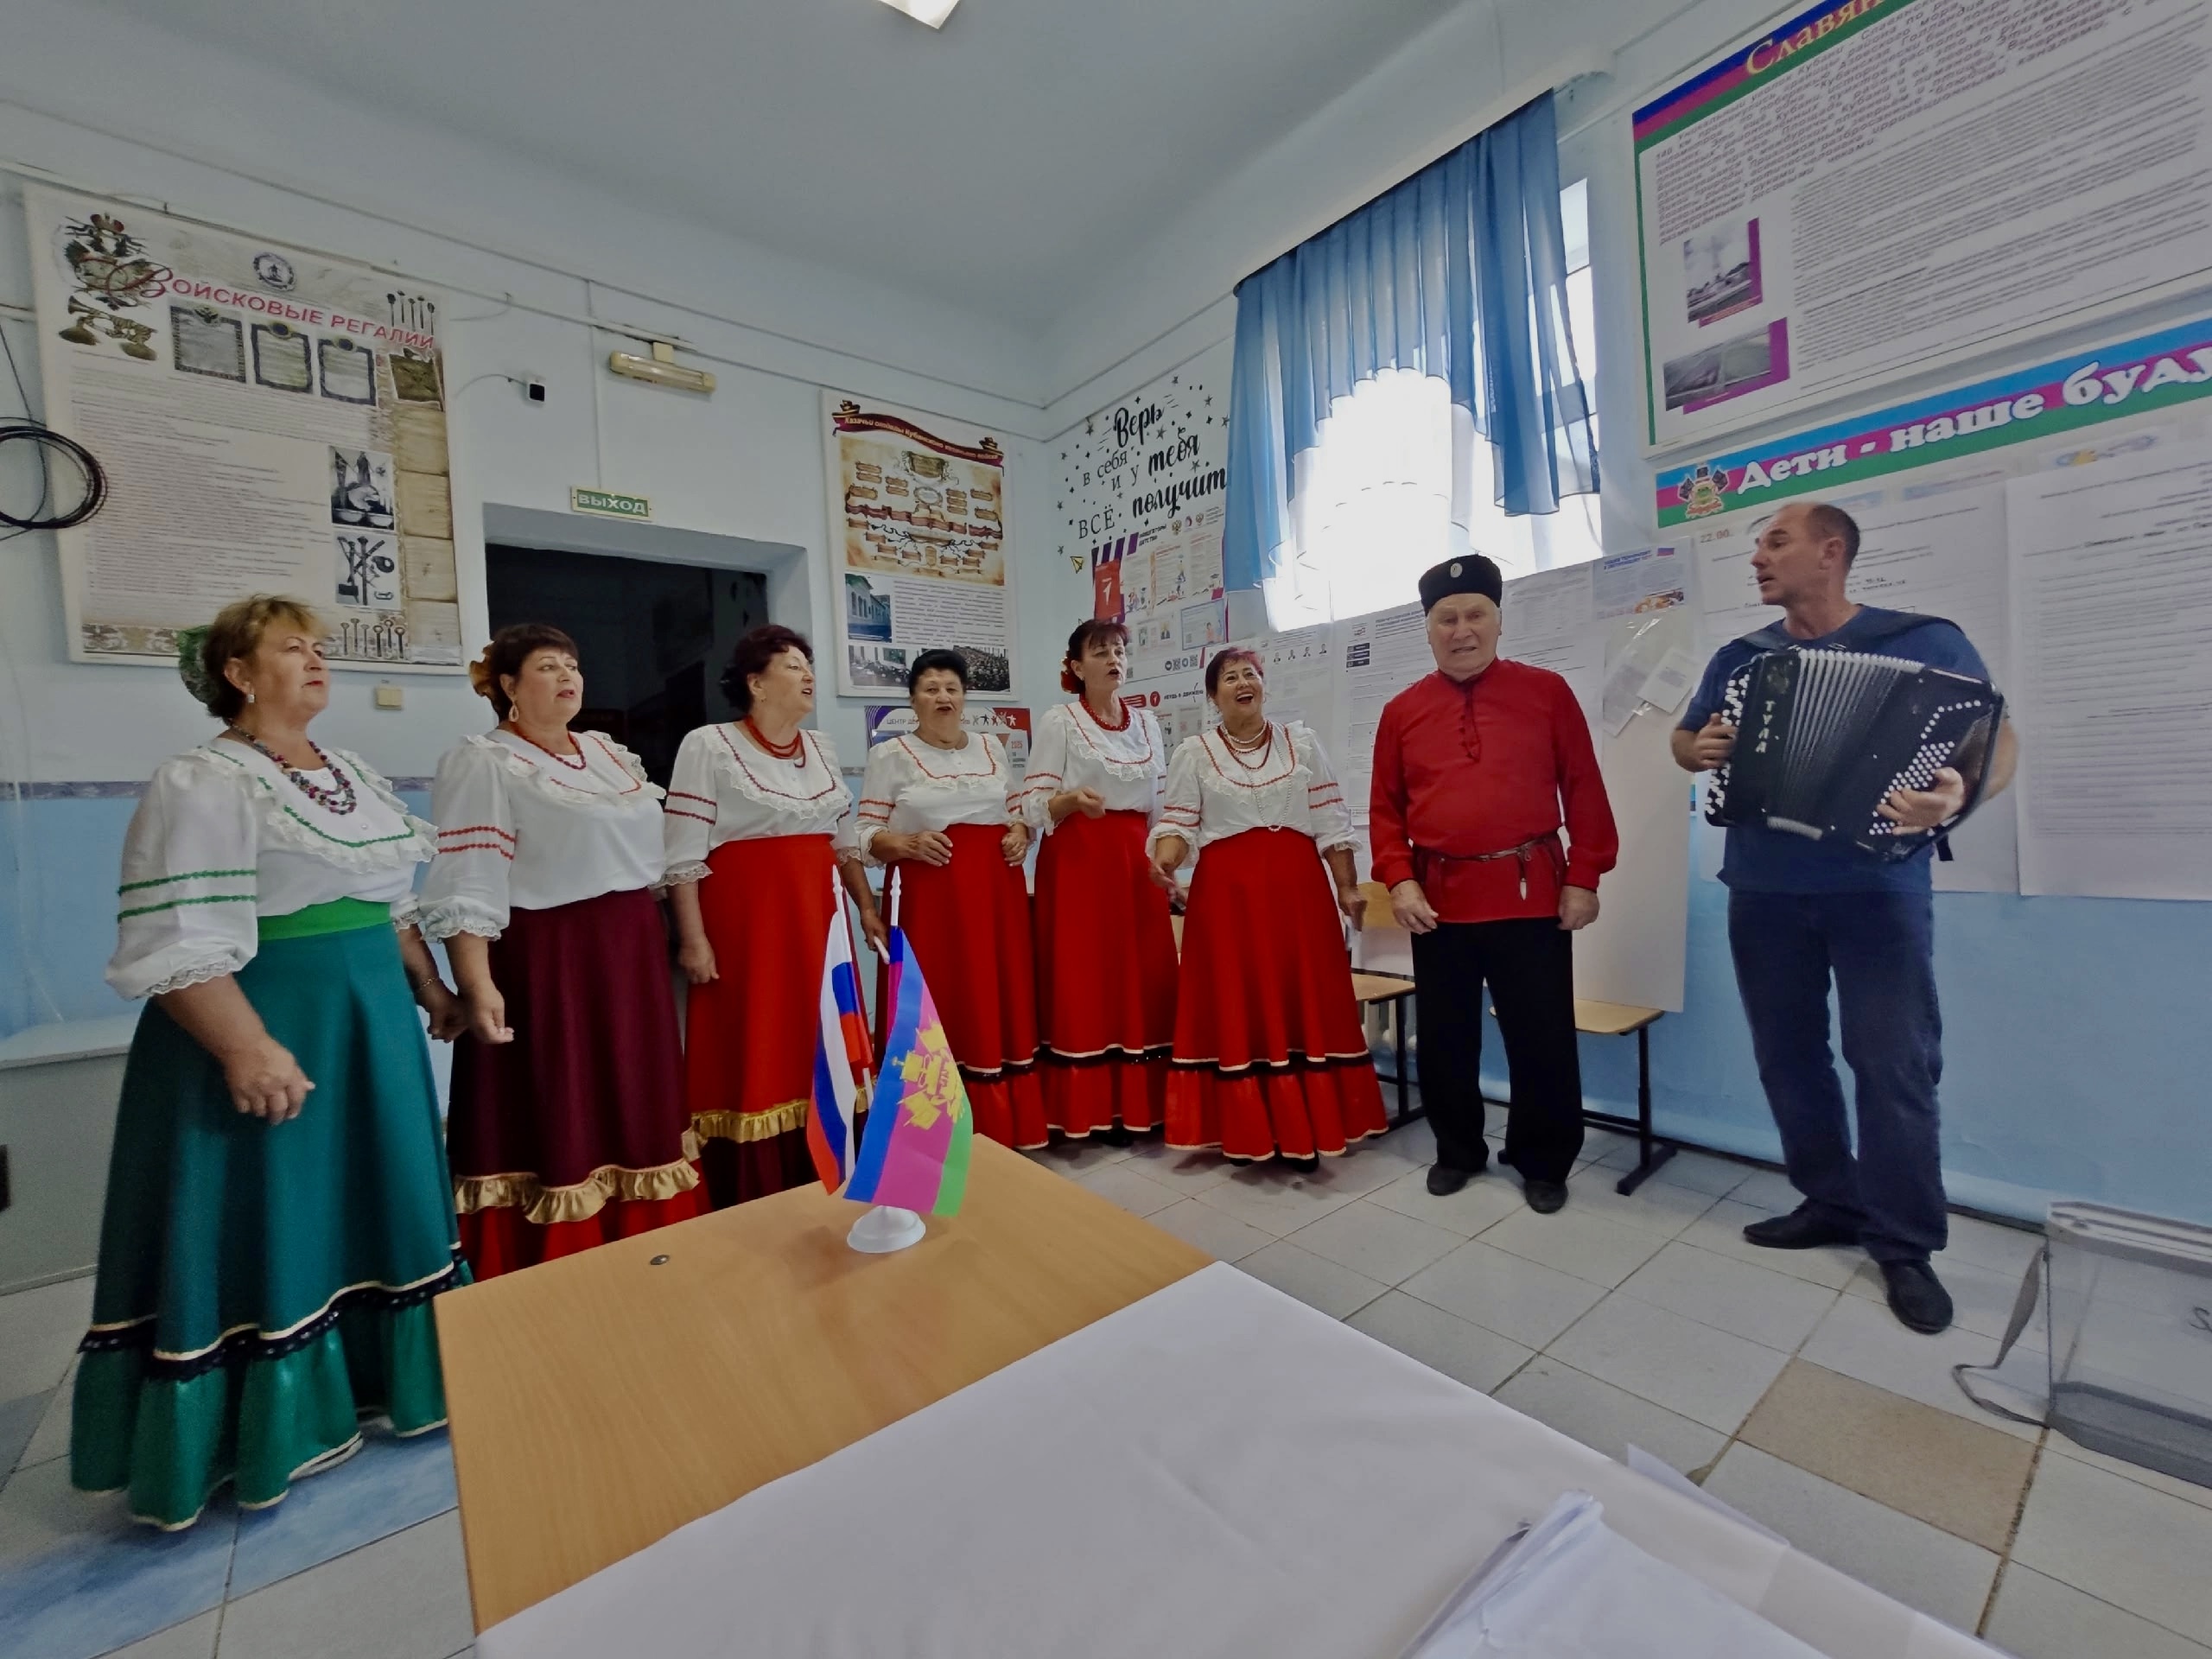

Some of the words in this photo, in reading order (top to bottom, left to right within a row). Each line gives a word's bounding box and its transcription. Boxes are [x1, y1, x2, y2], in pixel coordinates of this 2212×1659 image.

[106, 261, 323, 326] ВОЙСКОВЫЕ
[331, 315, 435, 349] РЕГАЛИИ
[1113, 404, 1165, 448] Верь
[1737, 444, 1847, 494] Дети
[1890, 394, 2045, 452] наше
[1083, 473, 1090, 486] в
[1097, 449, 1128, 478] себя
[1111, 477, 1121, 491] и
[1131, 464, 1140, 486] у
[1147, 427, 1200, 476] тебя
[578, 493, 646, 514] ВЫХОД
[1078, 505, 1115, 539] ВСЁ
